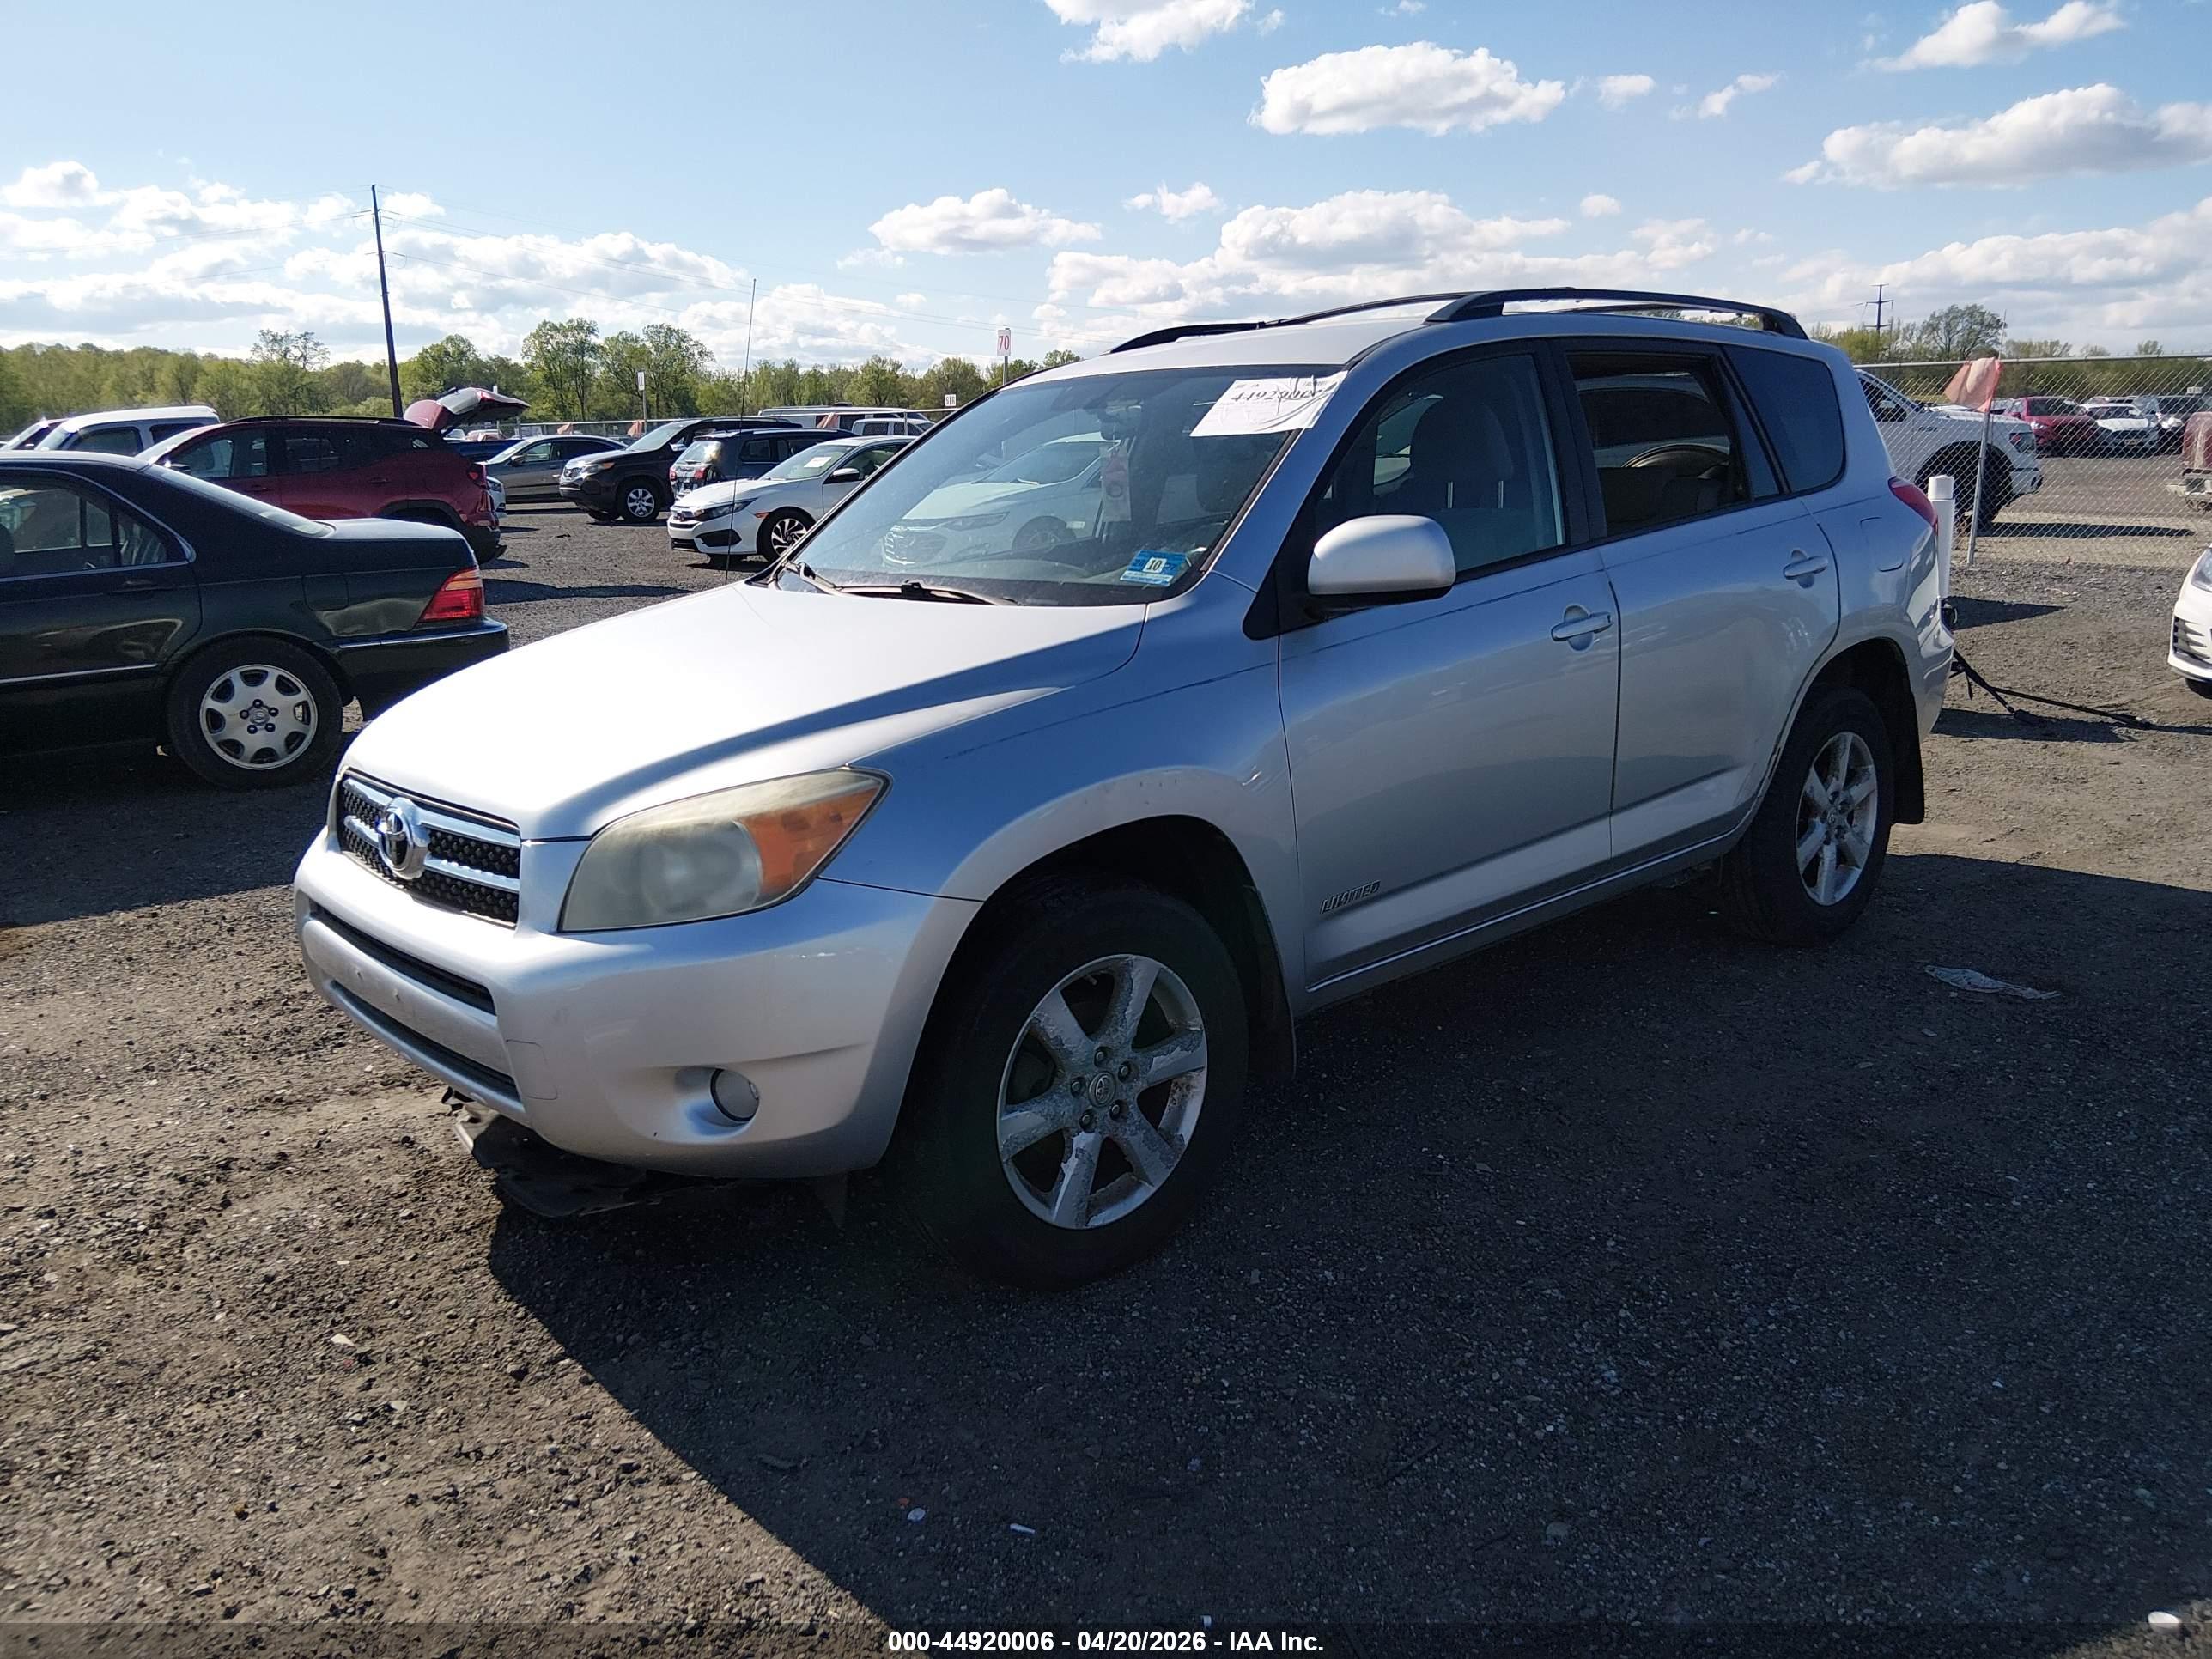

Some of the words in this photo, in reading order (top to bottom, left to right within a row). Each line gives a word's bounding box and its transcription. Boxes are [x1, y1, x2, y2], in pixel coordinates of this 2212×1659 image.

[998, 335, 1010, 351] 70
[1146, 560, 1163, 571] 10
[1320, 879, 1381, 915] LIMITED
